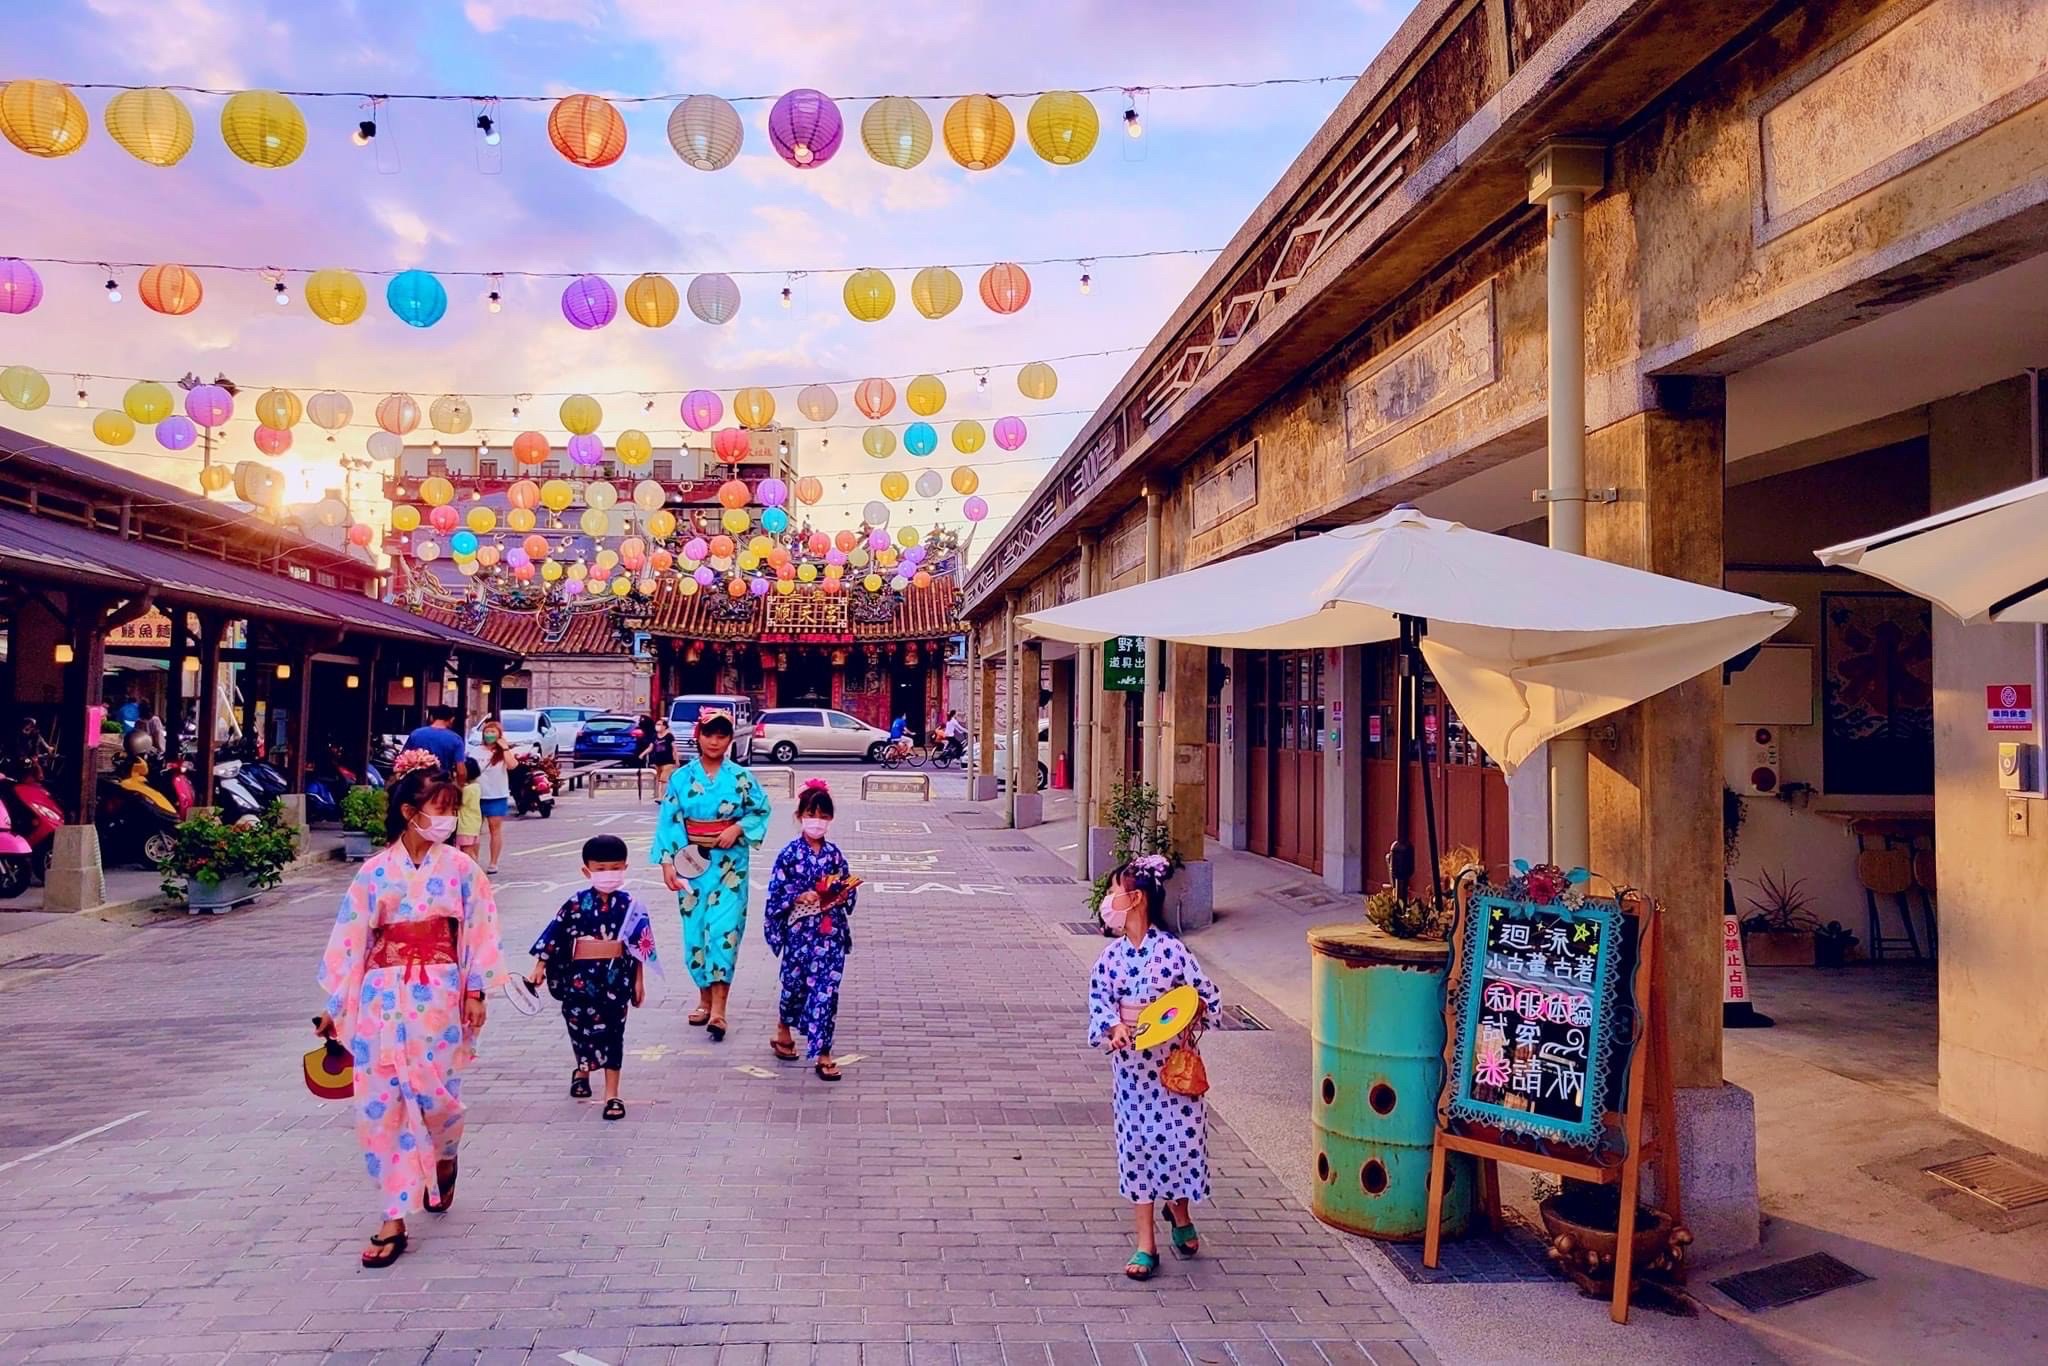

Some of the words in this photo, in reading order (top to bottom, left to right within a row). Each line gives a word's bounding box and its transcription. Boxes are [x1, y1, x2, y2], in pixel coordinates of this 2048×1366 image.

[775, 603, 838, 623] 順天宮
[1487, 952, 1595, 983] 小古董古著
[1726, 939, 1744, 998] 禁止占用
[1482, 1013, 1541, 1050] 試穿
